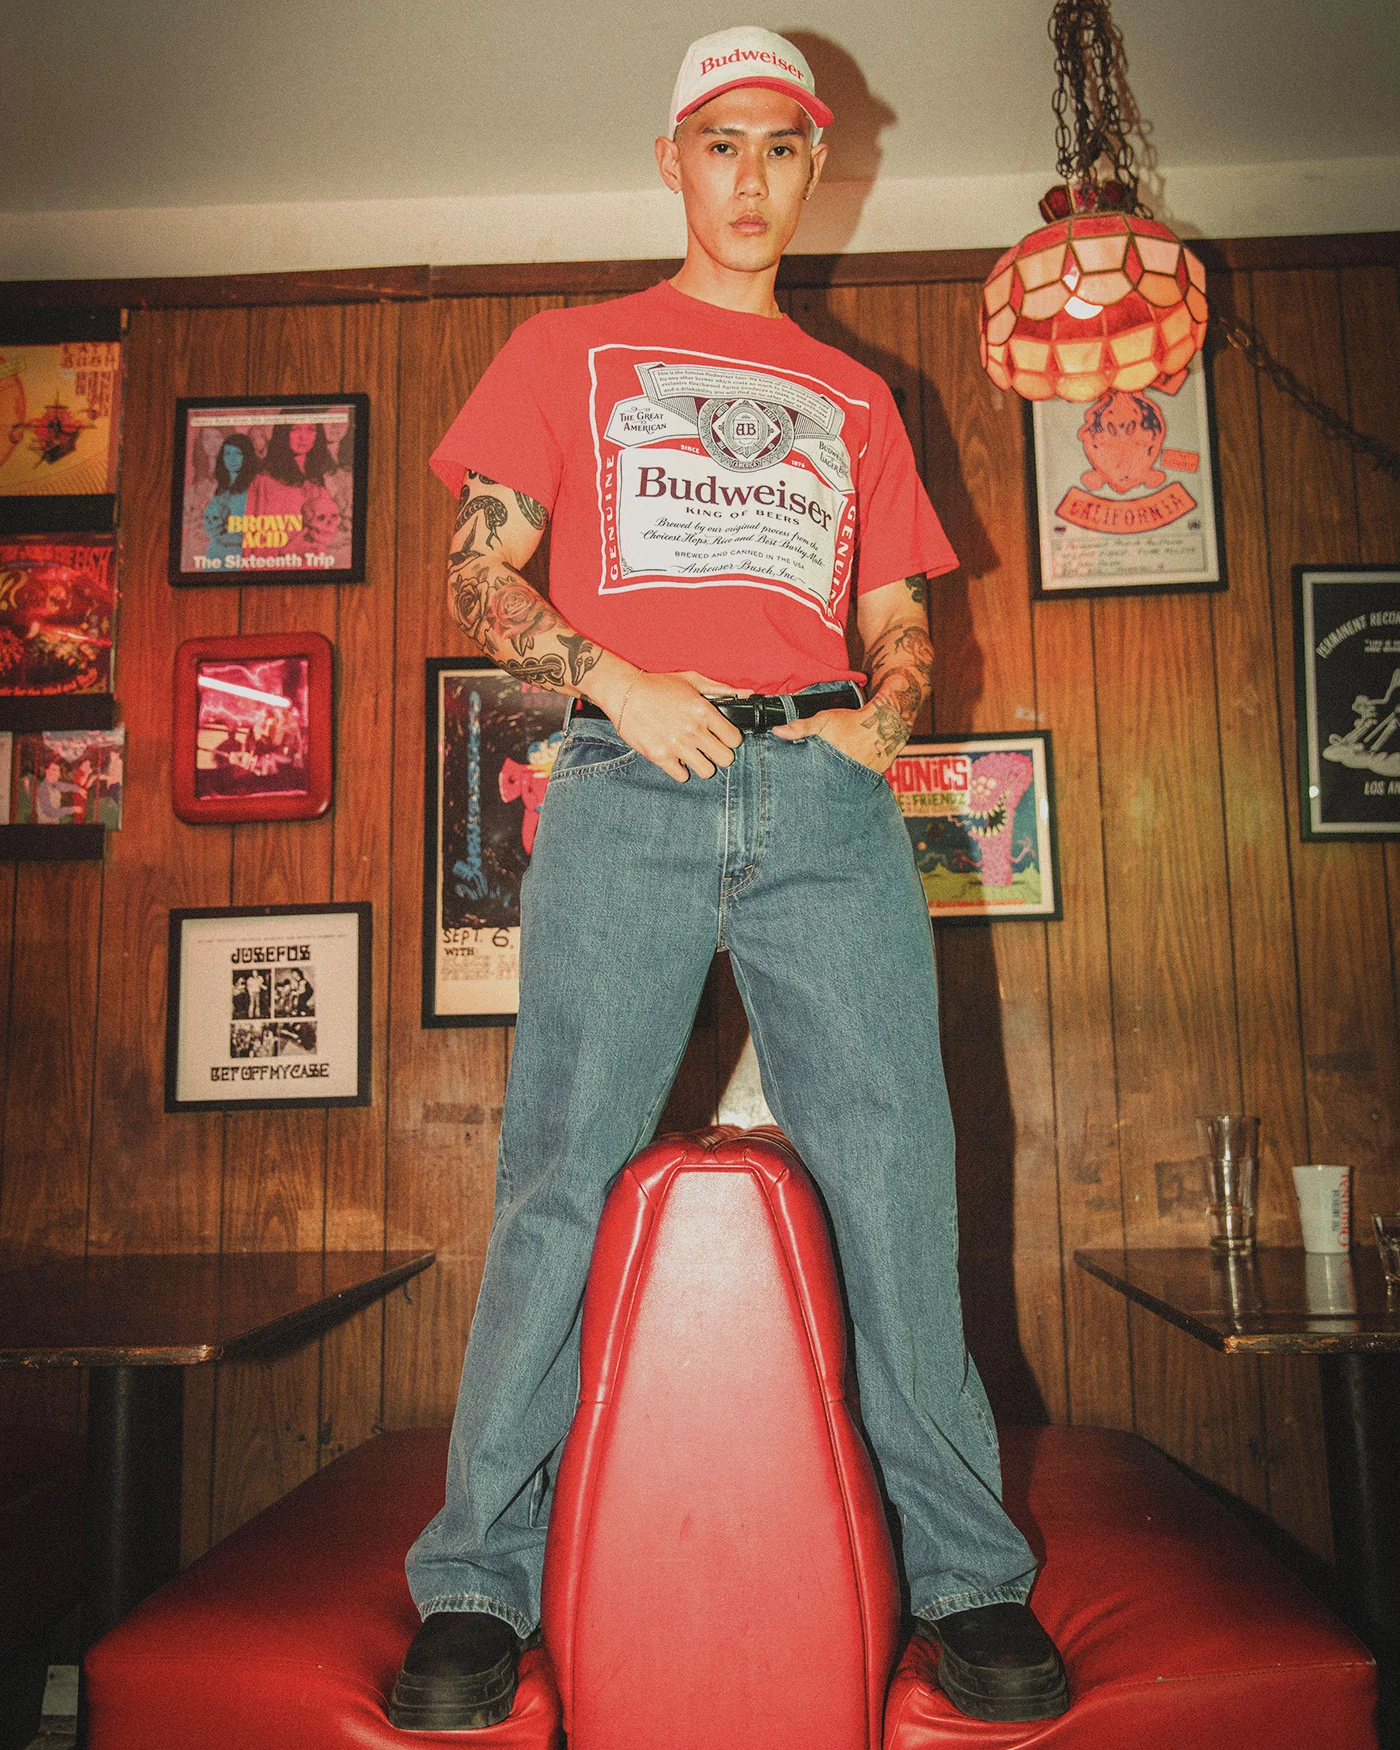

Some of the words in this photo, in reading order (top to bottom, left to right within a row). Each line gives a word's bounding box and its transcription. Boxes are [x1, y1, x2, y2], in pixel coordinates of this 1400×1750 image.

[700, 48, 804, 81] Budweiser
[619, 412, 635, 422] THE
[637, 411, 665, 421] GREAT
[623, 422, 667, 435] AMERICAN
[680, 444, 701, 454] SINCE
[635, 466, 832, 532] Budweiser
[604, 455, 619, 581] GENUINE
[686, 506, 722, 518] KING
[730, 509, 748, 519] OF
[756, 509, 800, 525] BEERS
[1069, 493, 1185, 527] CALIFORNIA
[228, 514, 303, 533] BROWN
[242, 530, 289, 549] ACID
[655, 517, 692, 529] Brewed
[694, 522, 706, 533] by
[707, 525, 722, 533] our
[724, 522, 760, 535] original
[760, 525, 790, 537] process
[790, 531, 809, 545] from
[809, 541, 819, 551] the
[641, 529, 681, 541] Choicest
[708, 534, 731, 545] Rice
[734, 534, 755, 542] and
[755, 533, 778, 546] Best
[778, 539, 807, 559] Barley
[193, 555, 222, 569] The
[224, 552, 303, 569] Sixteenth
[304, 552, 335, 569] Trip
[674, 550, 709, 559] BREWED
[711, 550, 728, 558] AND
[730, 549, 763, 558] CANNED
[776, 555, 791, 564] THE
[1315, 614, 1368, 659] PERMANENT
[1364, 780, 1386, 796] LOS
[231, 944, 311, 964] JOSEFUS
